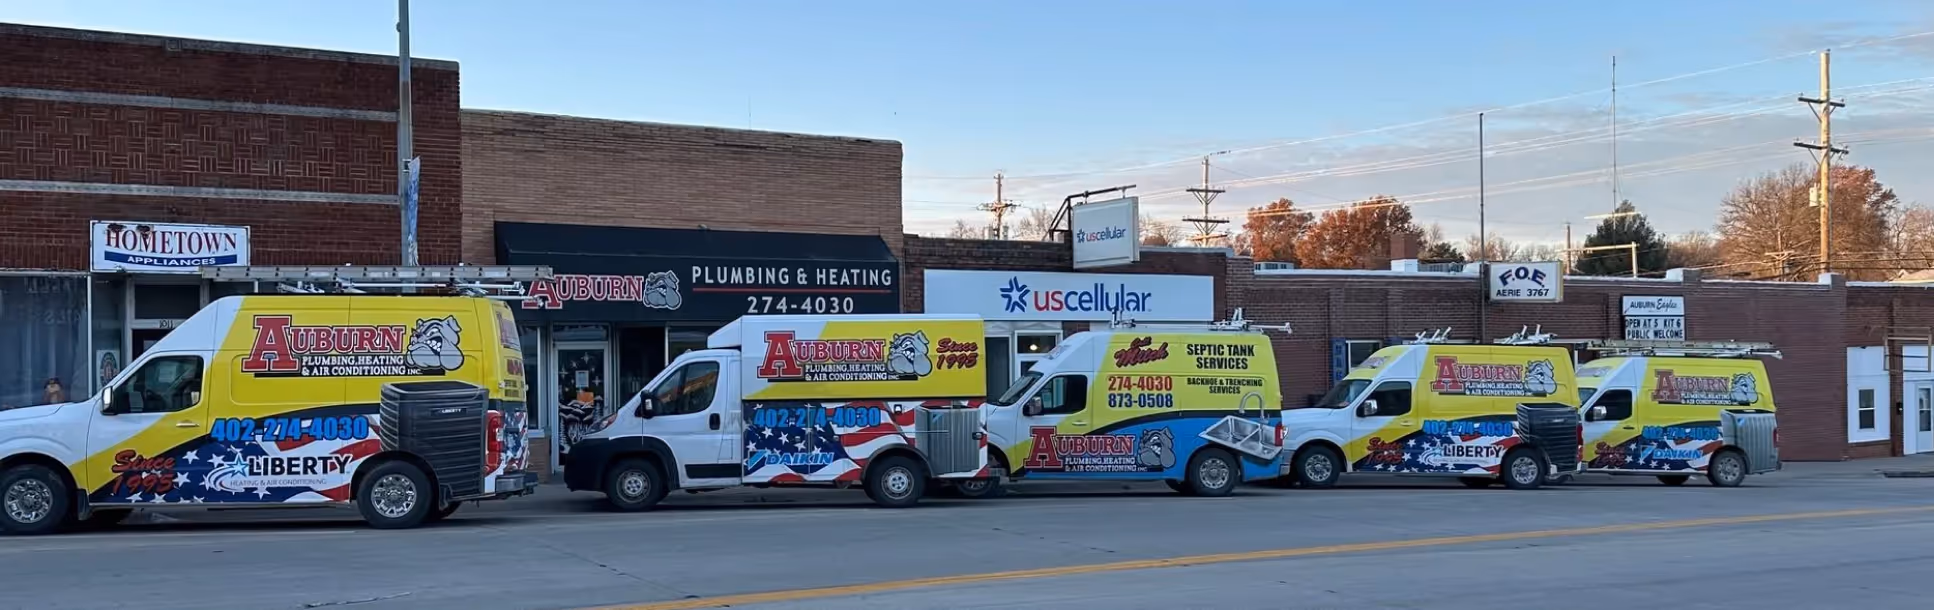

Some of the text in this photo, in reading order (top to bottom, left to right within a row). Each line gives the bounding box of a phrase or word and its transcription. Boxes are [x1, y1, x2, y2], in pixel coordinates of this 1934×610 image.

[105, 227, 237, 254] HOMETOWN
[1086, 225, 1127, 242] uscellular
[127, 256, 216, 266] APPLIANCES
[692, 265, 892, 286] PLUMBING & HEATING
[521, 274, 644, 309] AUBURN
[1033, 283, 1152, 312] uscellular
[1496, 288, 1550, 297] AERIE 3767
[747, 296, 854, 314] 274-4030
[1630, 300, 1656, 309] AUBURN
[1625, 318, 1681, 328] OPEN AT 5 KIT 6
[1627, 329, 1683, 339] PUBLIC WELCOME
[241, 315, 406, 373] AUBURN
[936, 338, 978, 354] Since
[1186, 344, 1255, 357] SEPTIC TANK
[757, 330, 886, 379] AUBURN
[936, 352, 978, 370] 1995
[302, 366, 310, 376] &
[311, 366, 330, 376] AIR
[331, 365, 406, 376] CONDITIONING
[1196, 357, 1248, 370] SERVICES
[813, 373, 828, 381] AIR
[829, 372, 887, 381] CONDITIONING
[1187, 377, 1218, 386] BACKHOE
[1225, 377, 1263, 387] TRENCHING
[1431, 355, 1523, 392] AUBURN
[1108, 375, 1173, 391] 274-4030
[1209, 386, 1241, 394] SERVICES
[1651, 368, 1730, 402] AUBURN
[1108, 393, 1173, 408] 873-0508
[753, 406, 881, 428] 402-274-4030
[210, 417, 370, 442] 402-274-4030
[1422, 420, 1514, 437] 402-274-4030
[1024, 425, 1135, 468] AUBURN
[1443, 445, 1503, 459] LIBERTY
[1652, 450, 1704, 460] DAIKIN
[111, 449, 175, 473] Since
[248, 455, 352, 476] LIBERTY
[766, 452, 835, 466] DAIKIN
[112, 472, 175, 494] 1995
